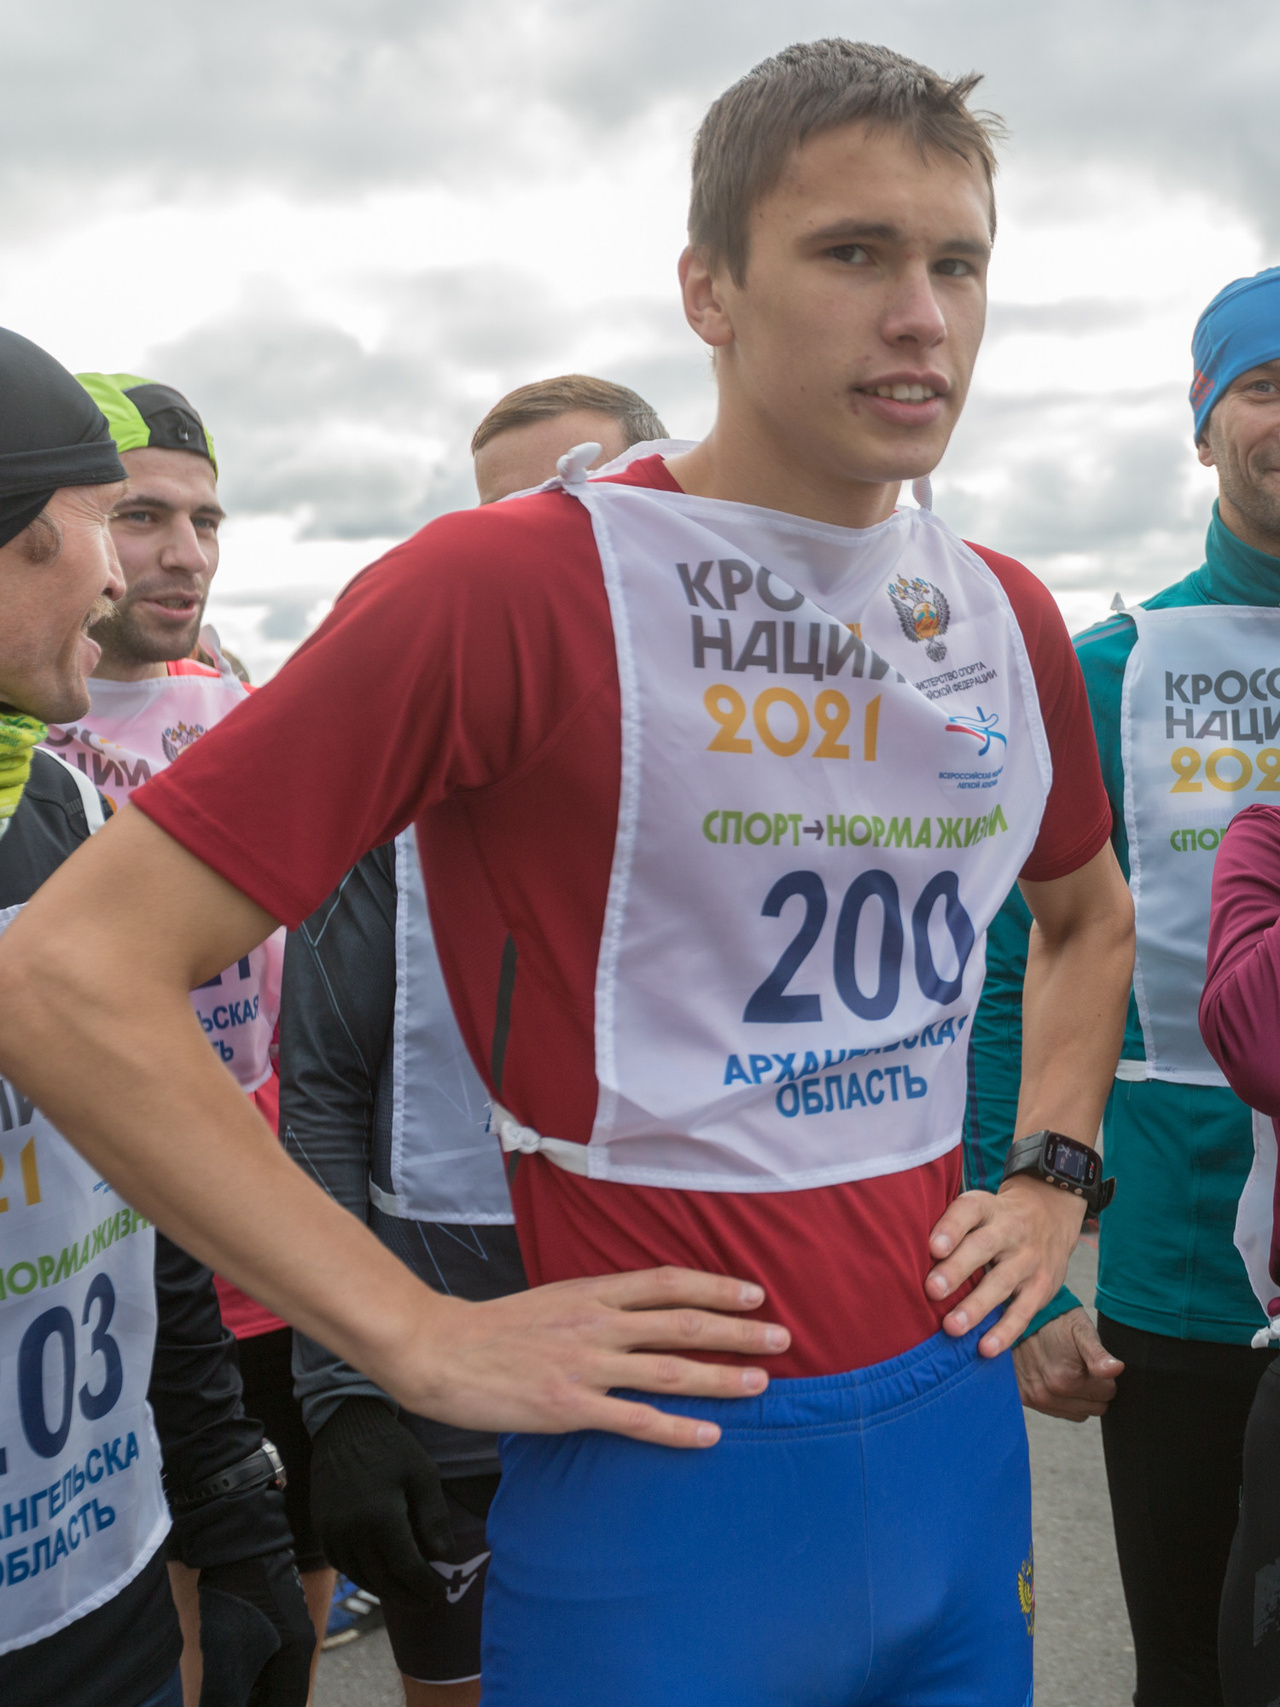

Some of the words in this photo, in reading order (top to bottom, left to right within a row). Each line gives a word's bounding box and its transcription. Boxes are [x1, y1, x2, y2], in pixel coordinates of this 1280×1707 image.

[675, 557, 806, 613] КРО
[958, 661, 987, 676] СПОРТА
[702, 683, 882, 762] 2021
[702, 810, 803, 846] СПОРТ
[826, 814, 931, 848] НОРМА
[742, 868, 976, 1024] 200
[775, 1064, 928, 1118] ОБЛАСТЬ
[0, 1272, 123, 1476] 03
[0, 1431, 139, 1540] НГЕЛЬСКА
[0, 1498, 116, 1588] БЛАСТЬ
